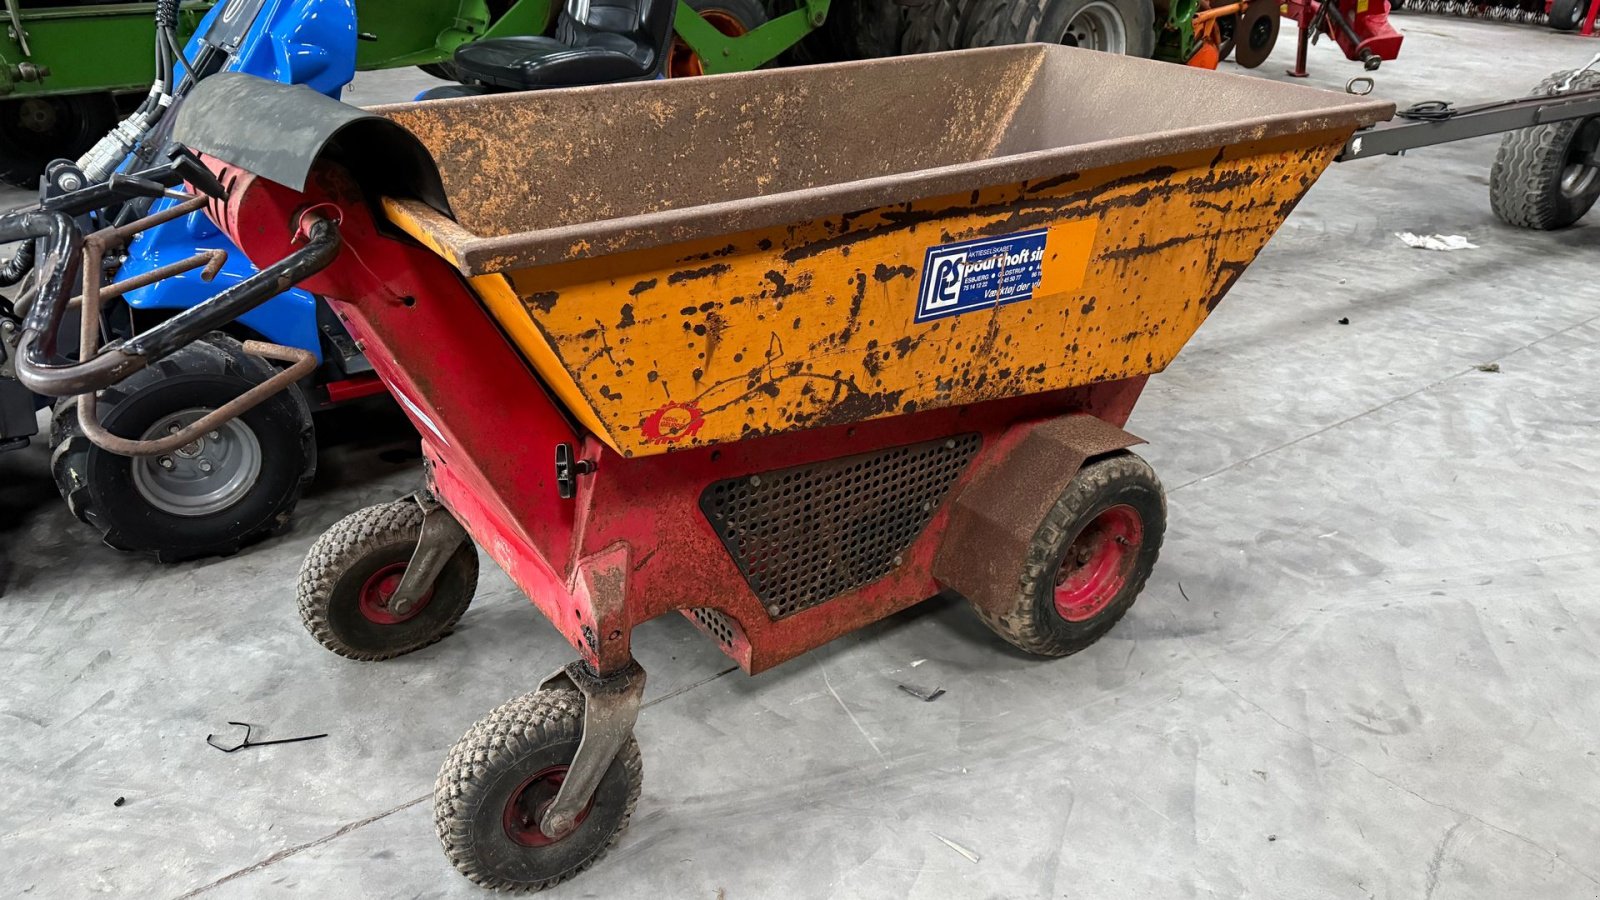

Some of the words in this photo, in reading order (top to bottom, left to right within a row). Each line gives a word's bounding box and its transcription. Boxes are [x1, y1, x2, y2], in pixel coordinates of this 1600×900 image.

[968, 245, 1013, 258] AKTIESELSKABET
[964, 254, 996, 277] poul
[997, 248, 1030, 268] thoft
[965, 274, 989, 284] ESBJERG
[1016, 282, 1030, 292] der
